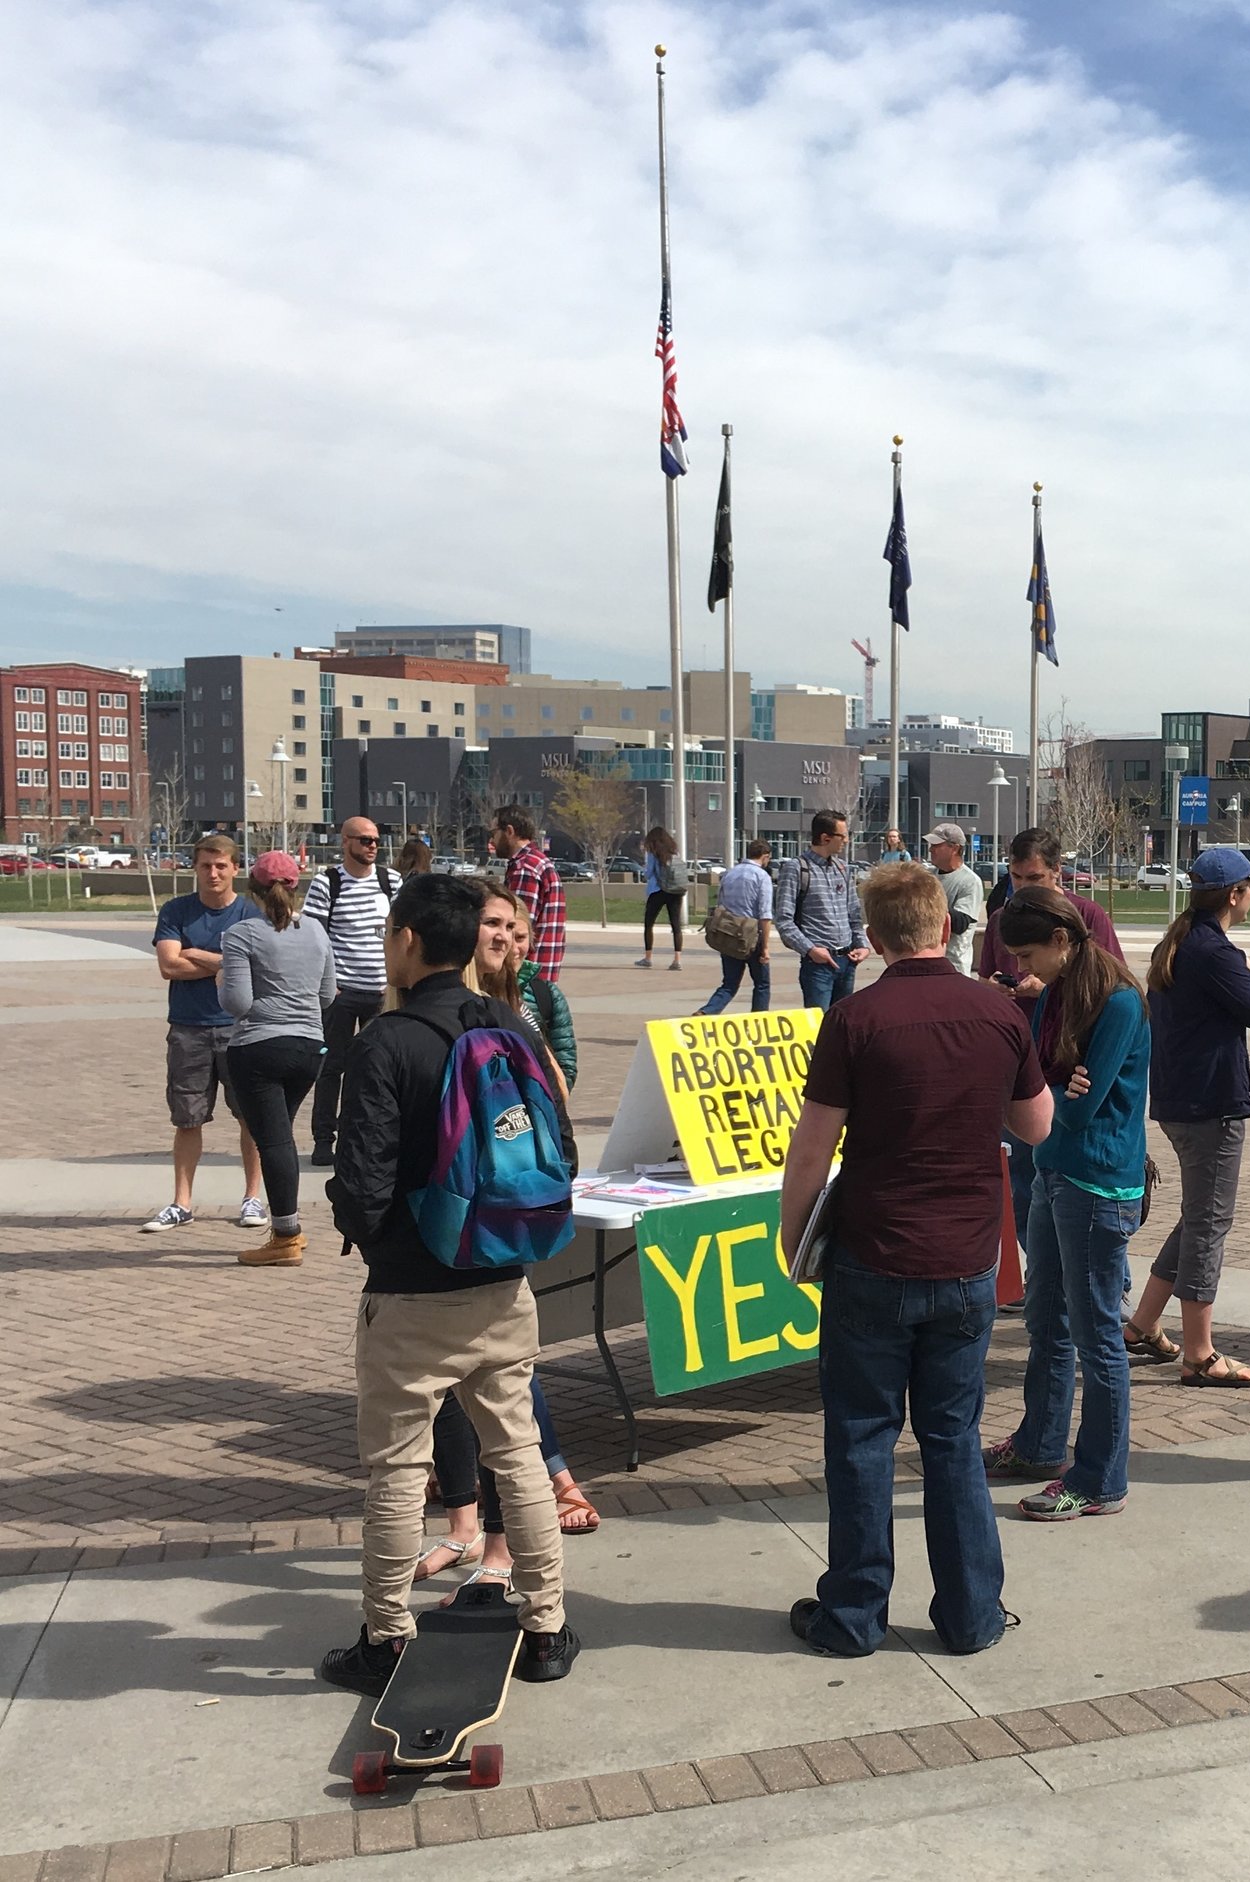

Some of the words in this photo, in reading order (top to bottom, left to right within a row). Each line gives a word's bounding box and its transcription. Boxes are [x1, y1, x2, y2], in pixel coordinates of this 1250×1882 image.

[541, 753, 569, 767] MSU
[802, 760, 831, 775] MSU
[680, 1016, 795, 1049] SHOULD
[504, 1110, 526, 1123] VANS
[699, 1085, 806, 1133] REMAI
[706, 1126, 797, 1176] LEG
